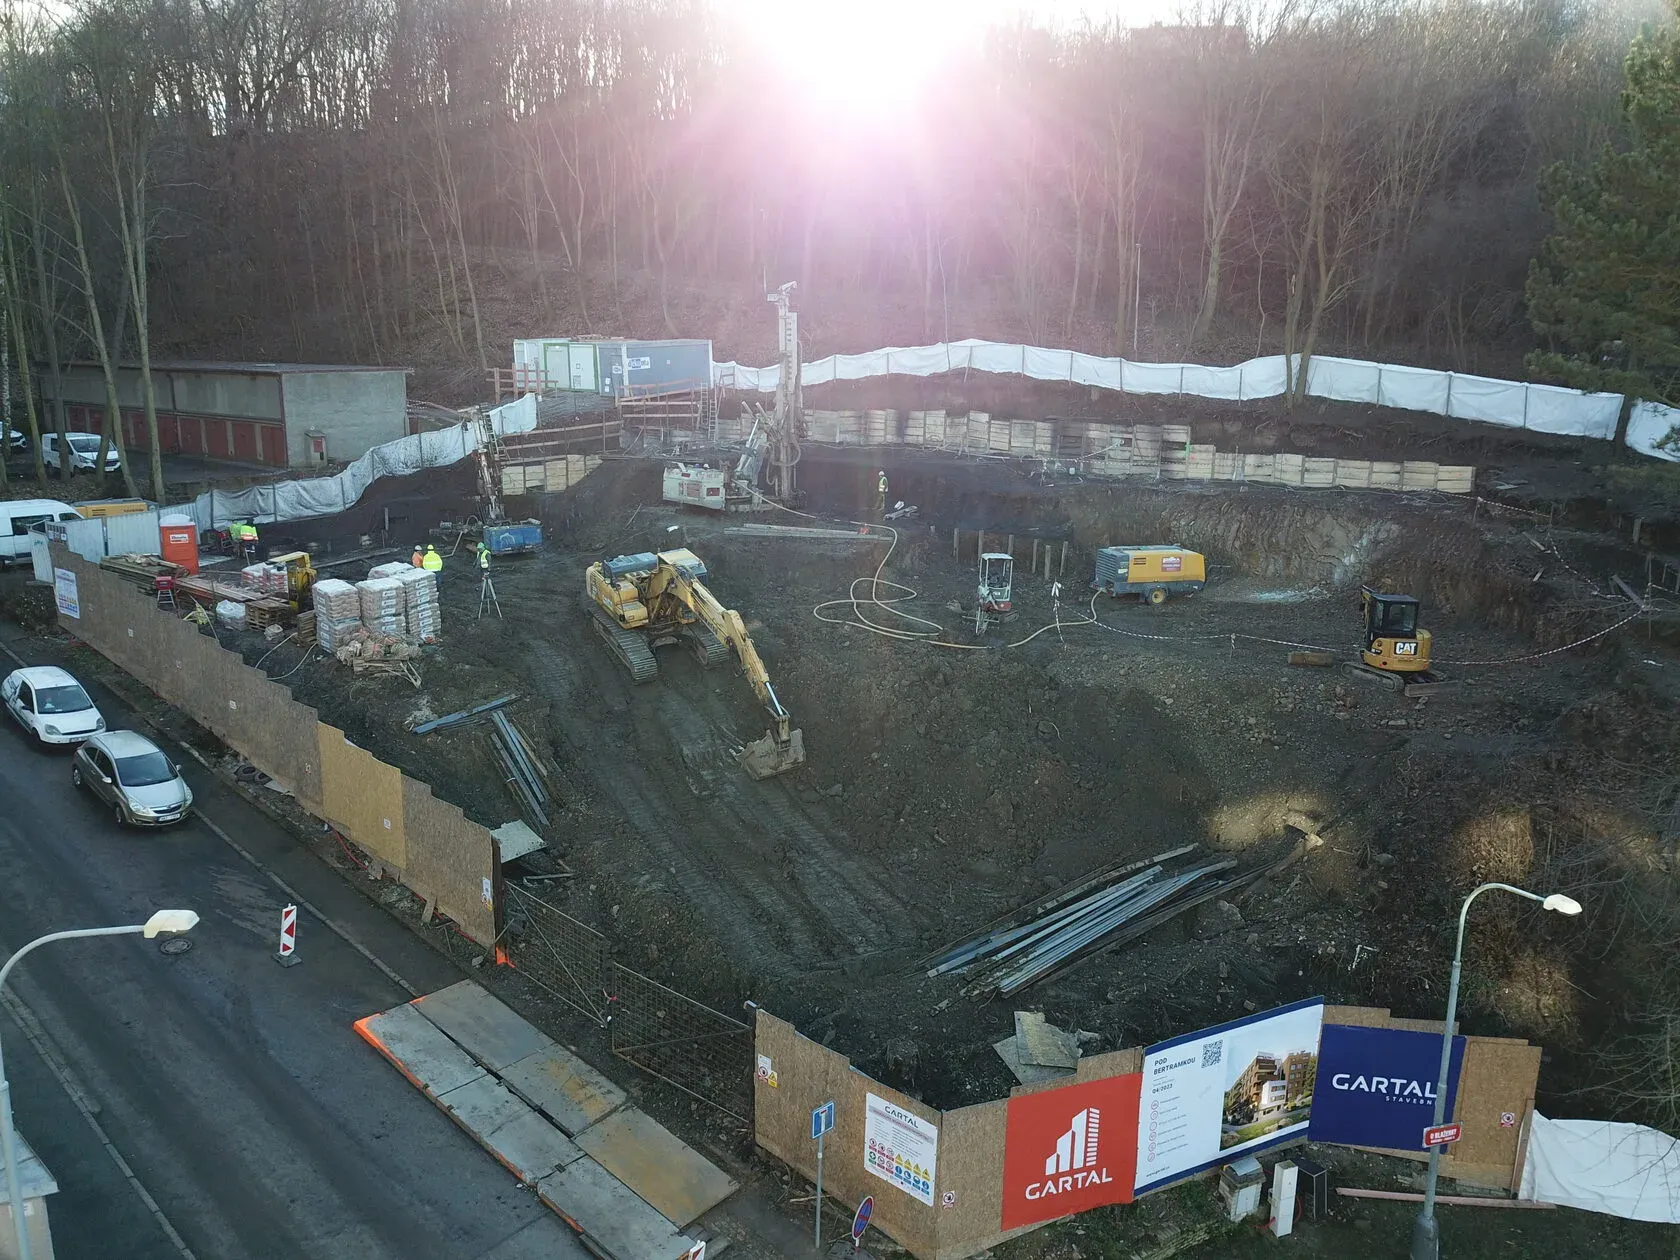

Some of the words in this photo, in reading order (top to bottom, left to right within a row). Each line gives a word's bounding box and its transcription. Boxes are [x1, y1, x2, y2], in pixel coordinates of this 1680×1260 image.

[1396, 643, 1416, 655] CAT
[1153, 1057, 1196, 1076] BERTRAMKOU
[1154, 1057, 1168, 1067] POD
[1332, 1073, 1437, 1098] GARTAL
[1385, 1095, 1434, 1106] STAVEBN
[1025, 1167, 1113, 1200] GARTAL
